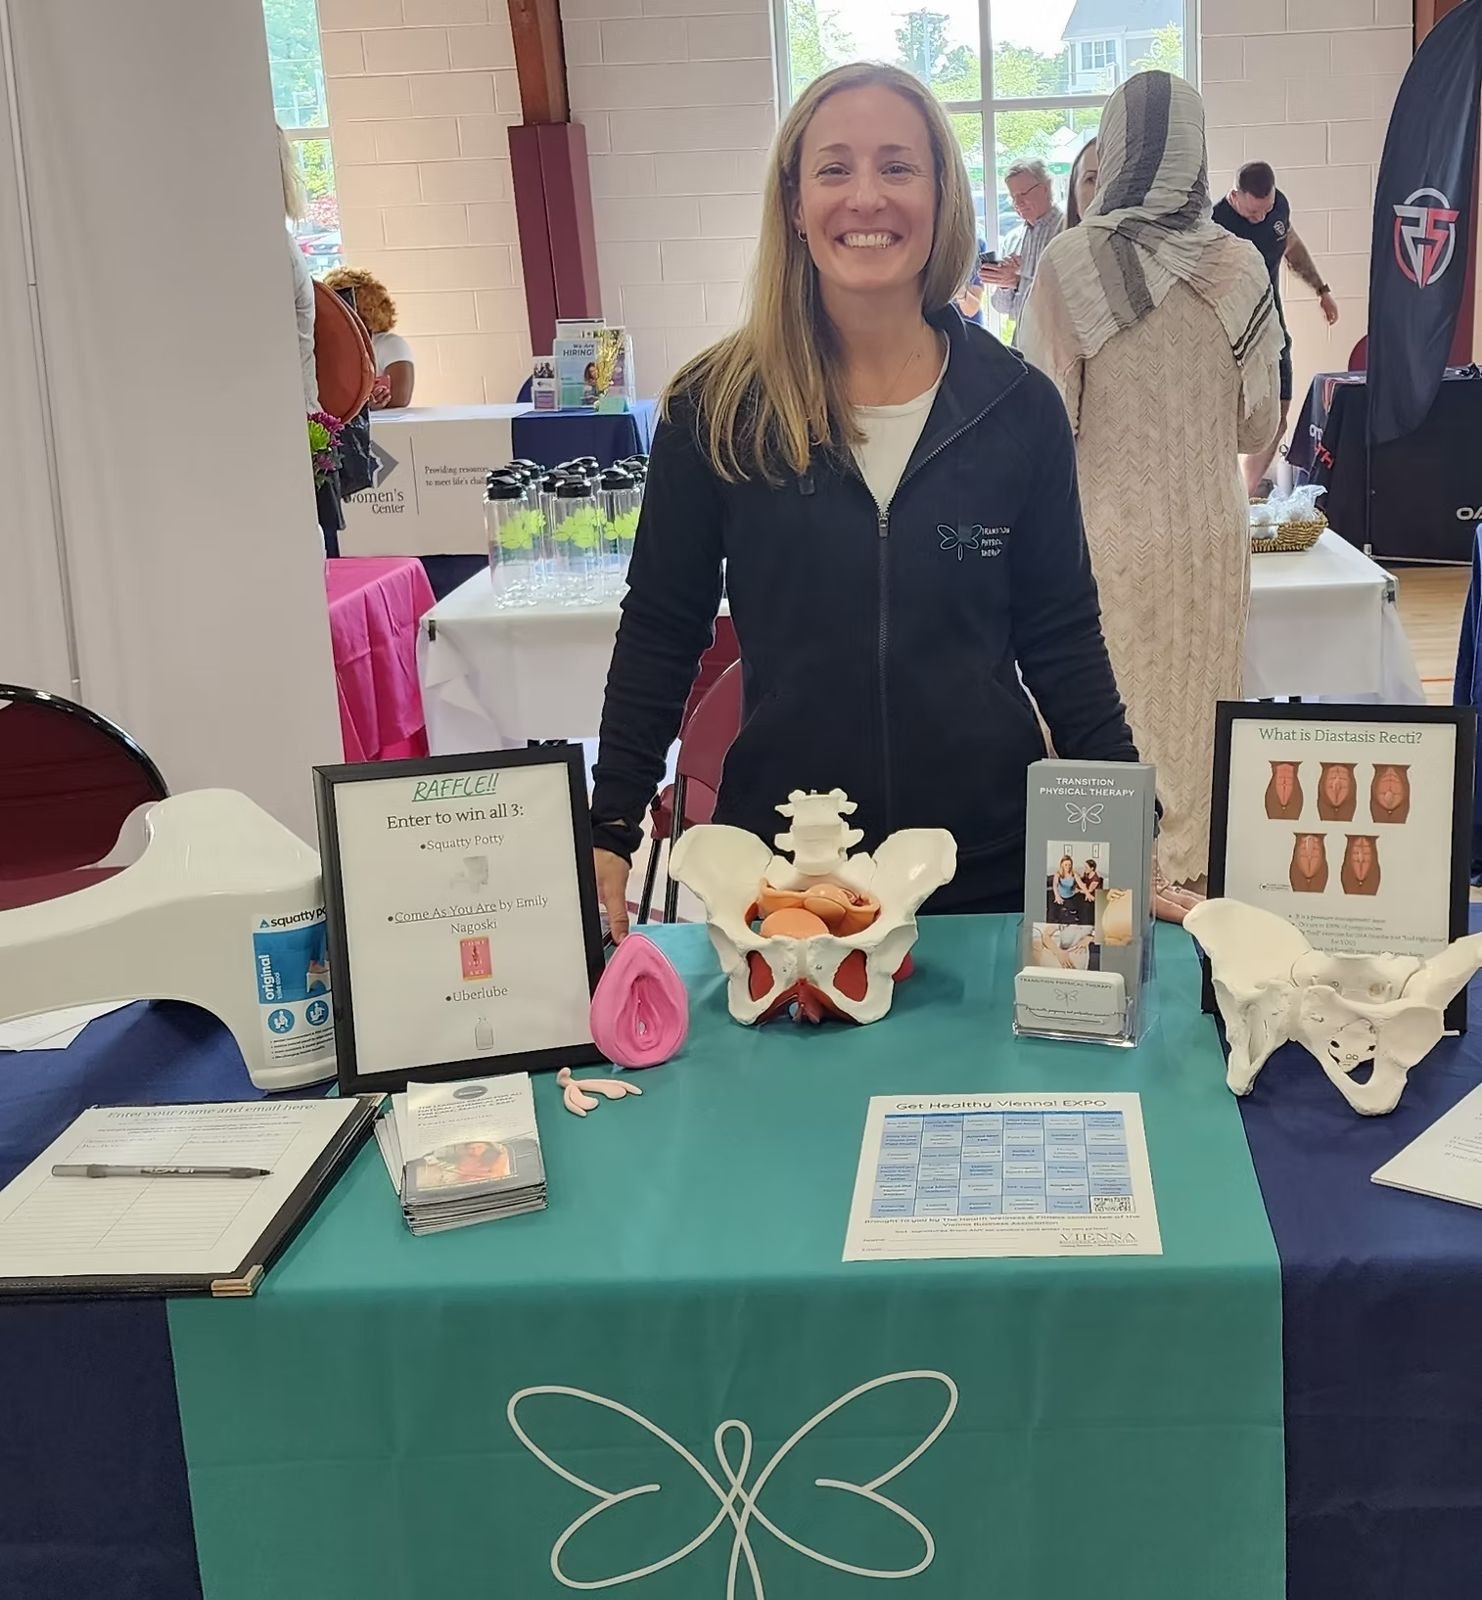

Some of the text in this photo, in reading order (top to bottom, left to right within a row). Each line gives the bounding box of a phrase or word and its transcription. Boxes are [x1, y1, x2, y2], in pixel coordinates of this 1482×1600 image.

[372, 503, 405, 514] Center
[1259, 728, 1423, 744] What is Diastasis Recti?
[412, 773, 500, 802] RAFFLE!!
[1056, 777, 1114, 786] TRANSITION
[1040, 787, 1134, 797] PHYSICAL THERAPY
[386, 803, 524, 829] Enter to win all 3:
[427, 833, 505, 852] Squatty Potty
[395, 895, 548, 923] Come As You Are by Emily
[271, 910, 315, 927] squatty
[451, 919, 497, 935] Nagoski
[258, 955, 275, 1000] original
[453, 985, 508, 1002] Uberlube
[245, 1104, 281, 1112] email
[896, 1102, 923, 1110] Get
[930, 1101, 992, 1109] Healthy
[1060, 1232, 1136, 1241] VIENNA
